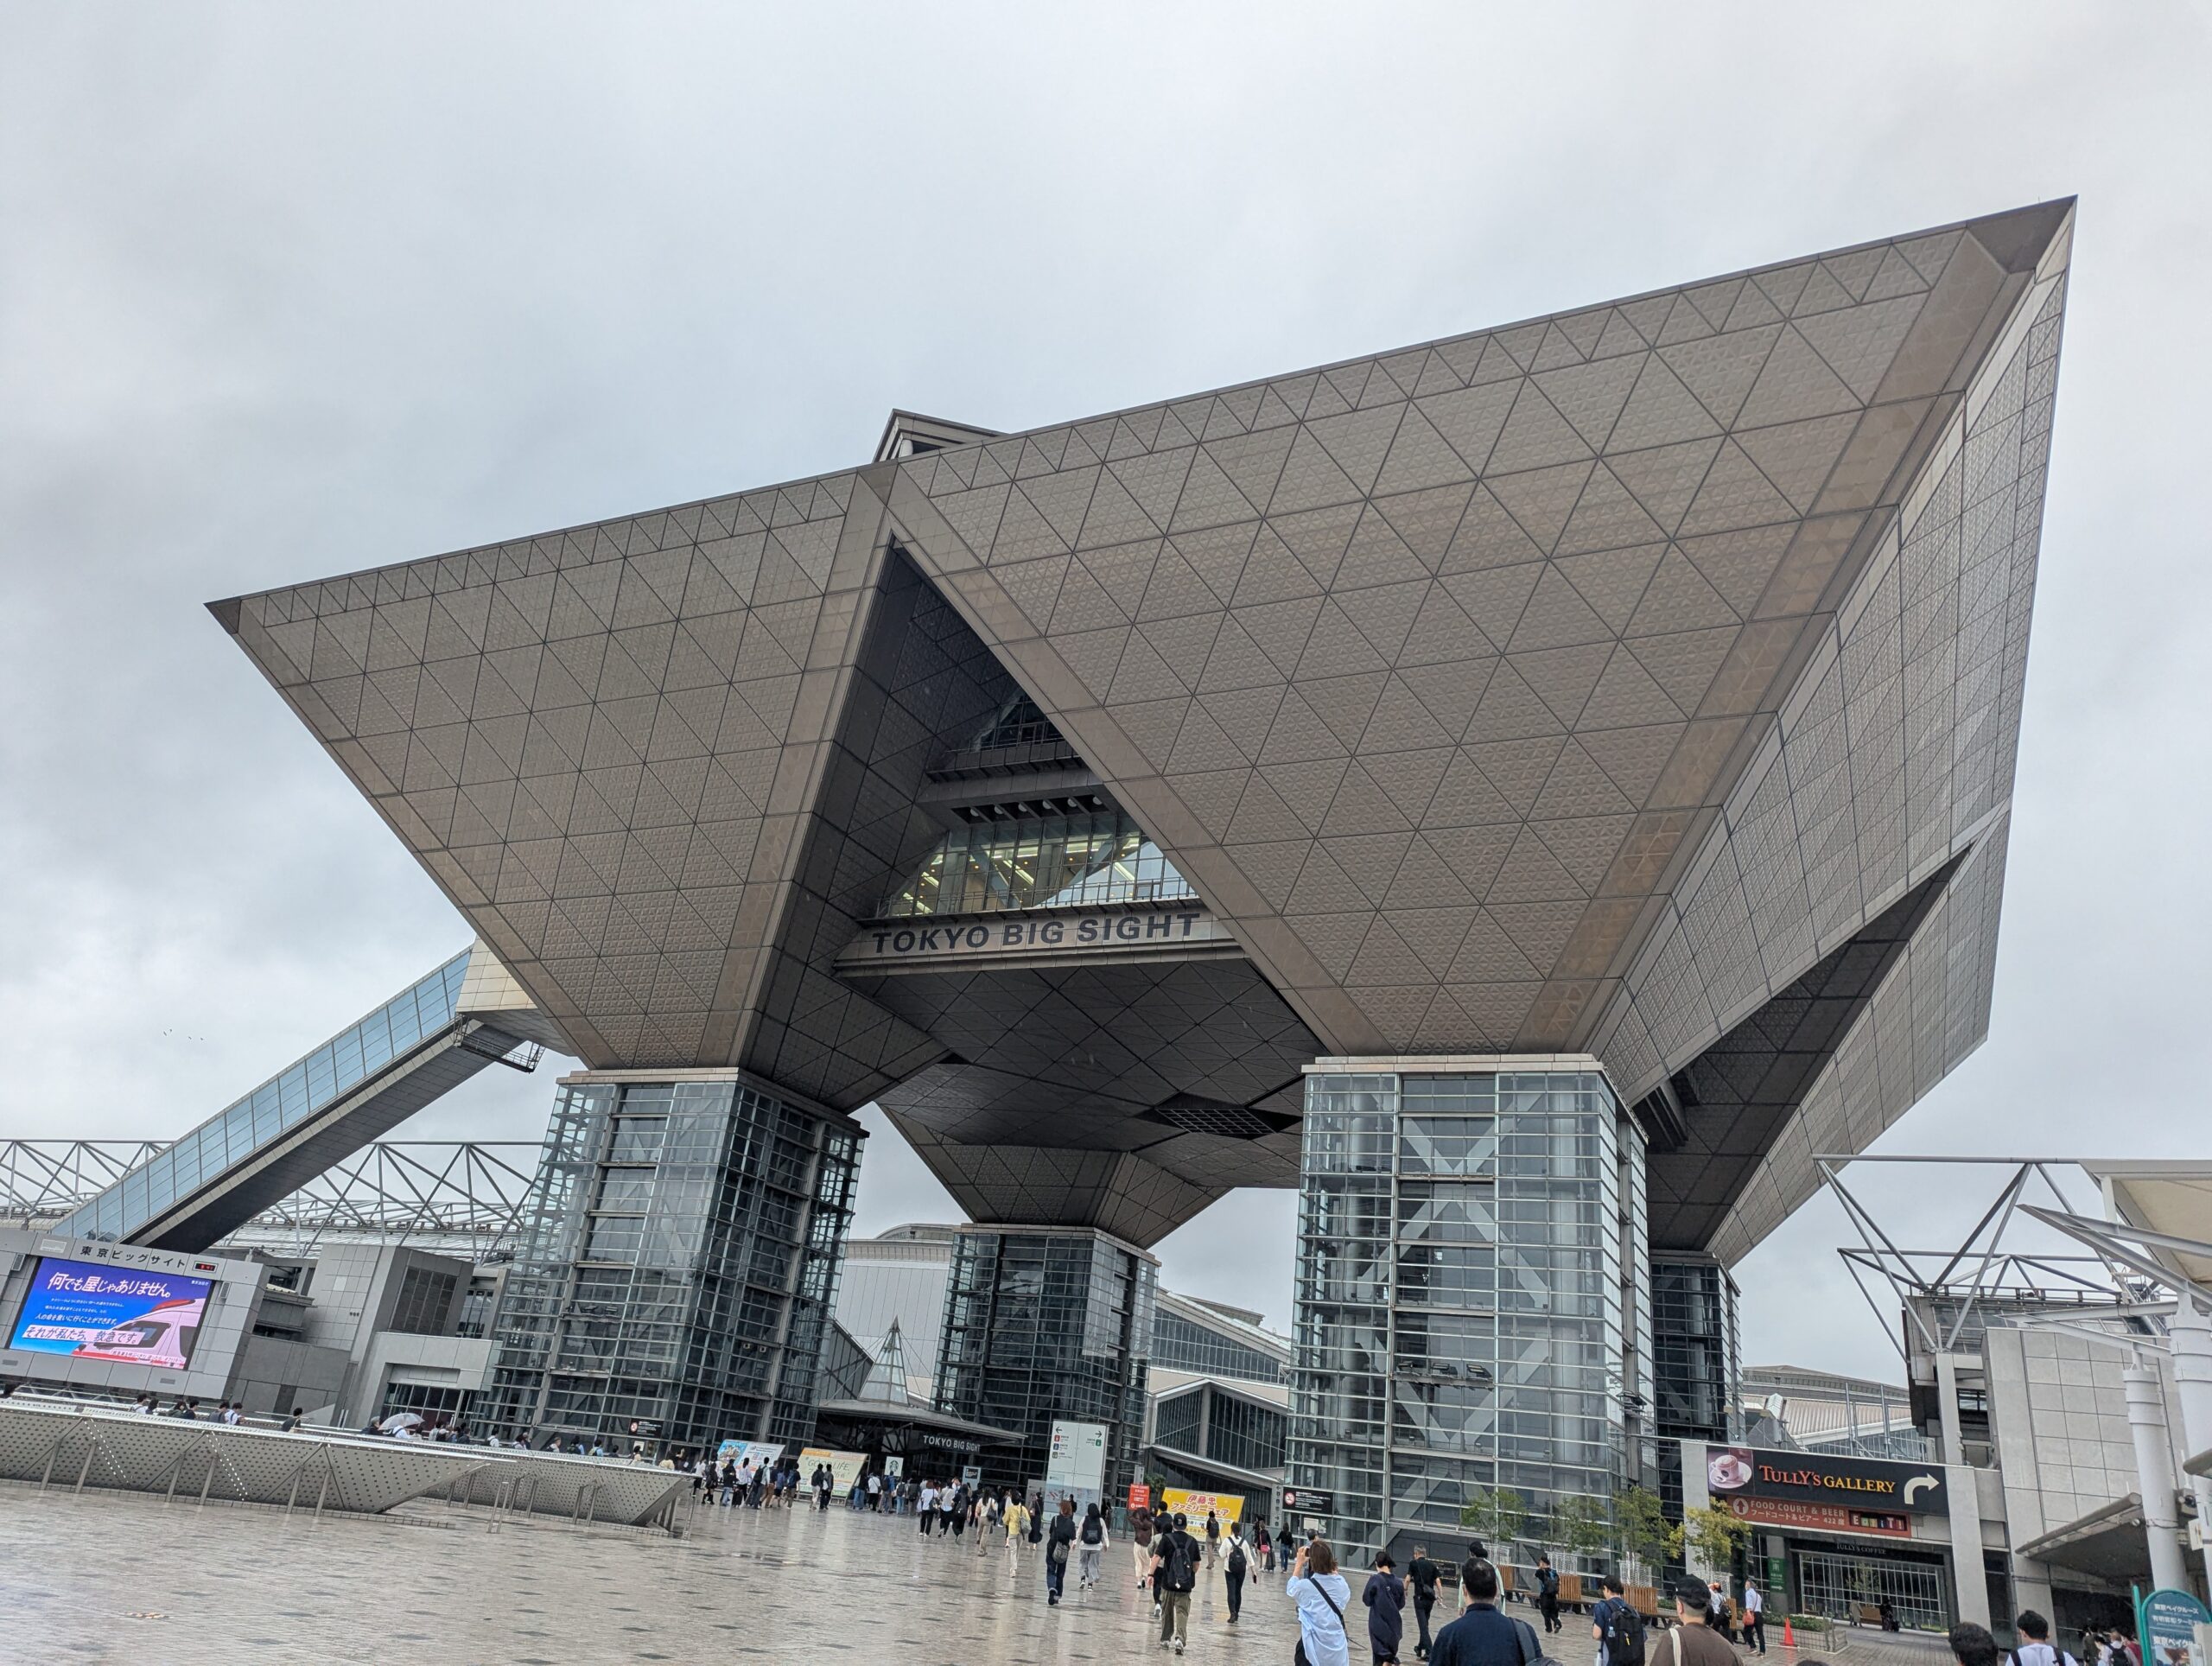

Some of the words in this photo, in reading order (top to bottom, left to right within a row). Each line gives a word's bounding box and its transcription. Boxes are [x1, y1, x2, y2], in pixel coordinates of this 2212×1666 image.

[873, 925, 989, 953] TOKYO
[1002, 921, 1065, 946] BIG
[1077, 912, 1200, 943] SIGHT
[80, 1246, 185, 1268] 東京ビッグサイト
[48, 1271, 171, 1298] 何でも屋じゃありません。
[923, 1435, 951, 1447] TOKYO
[953, 1440, 964, 1449] BIG
[966, 1442, 981, 1452] SIGHT
[1759, 1465, 1821, 1486] TULLY'S
[1823, 1476, 1895, 1493] GALLERY
[1188, 1494, 1217, 1505] 伊藤忠
[1751, 1500, 1775, 1510] FOOD
[1778, 1504, 1807, 1513] COURT
[1821, 1508, 1844, 1517] BEER
